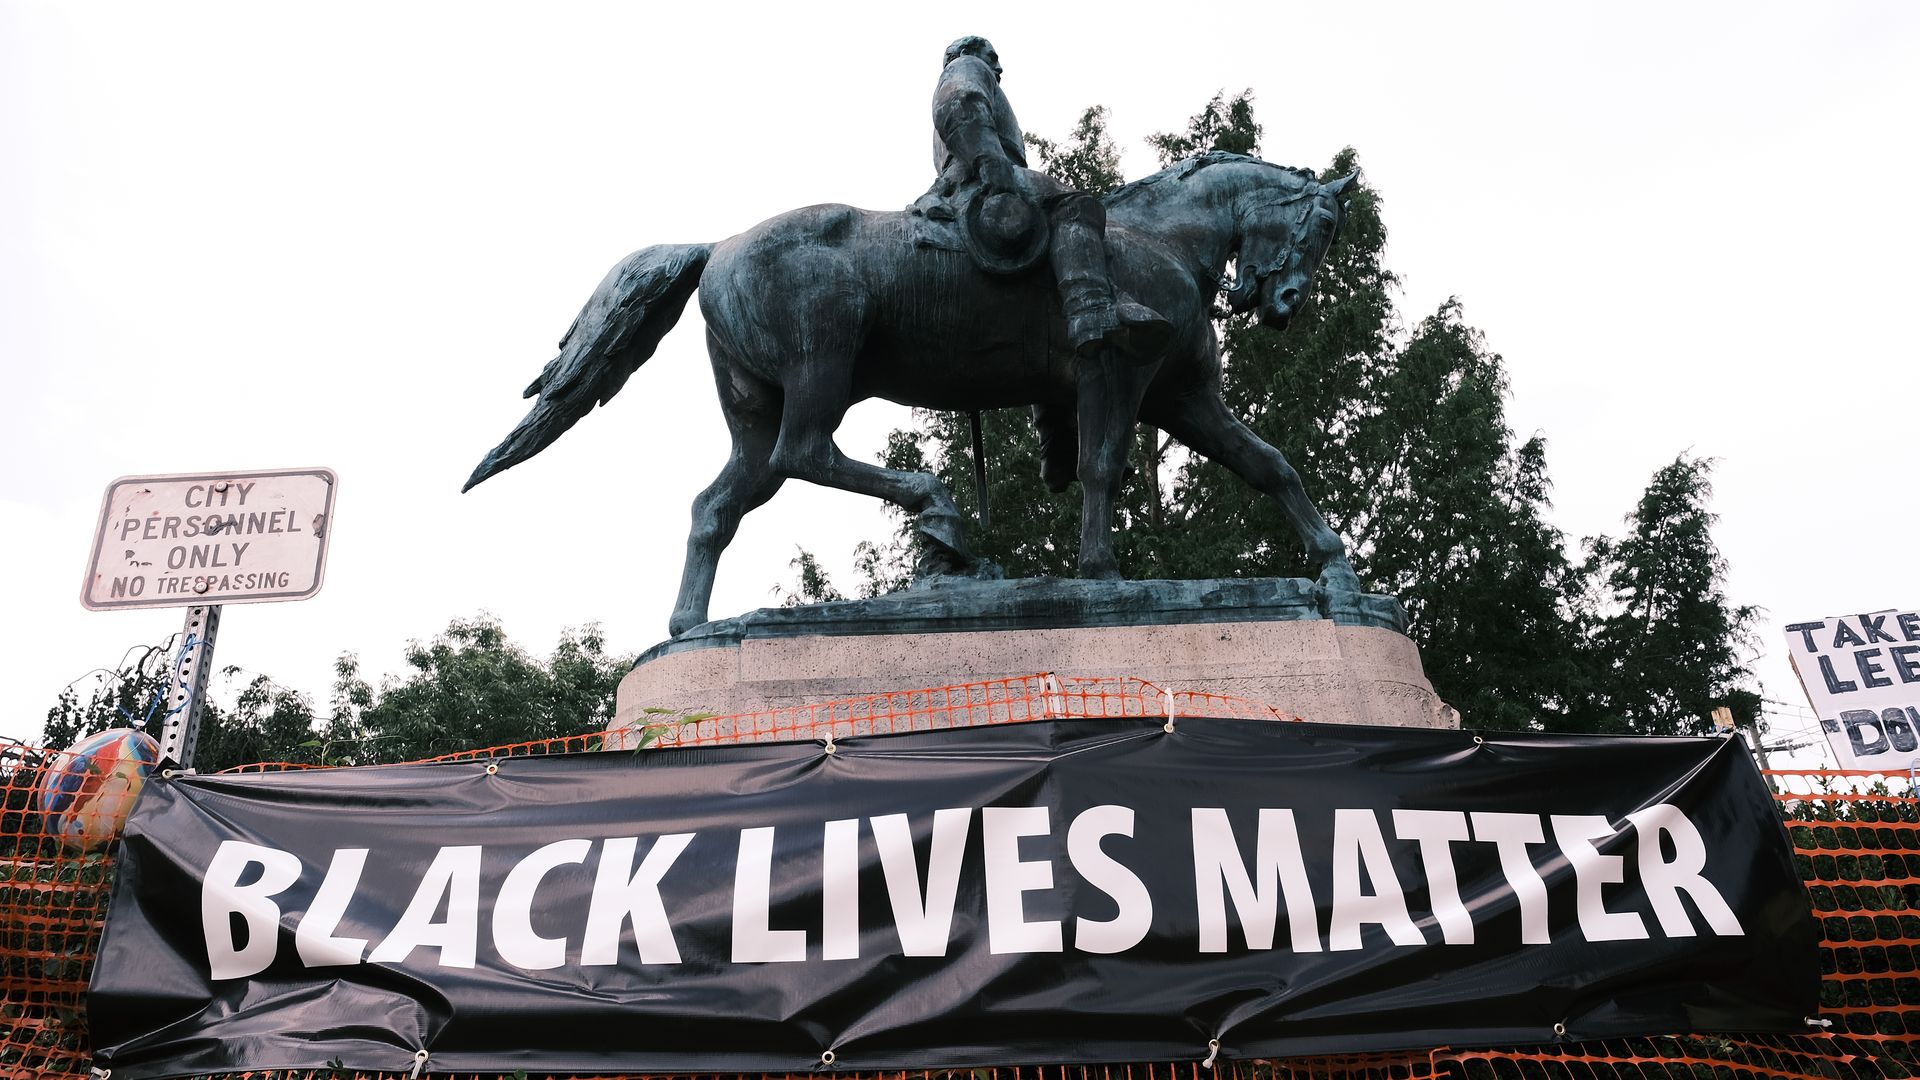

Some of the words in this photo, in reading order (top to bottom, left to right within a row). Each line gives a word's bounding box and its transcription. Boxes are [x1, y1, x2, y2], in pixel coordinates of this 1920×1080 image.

[185, 482, 255, 508] CITY
[120, 510, 301, 541] PERSONNEL
[167, 542, 250, 570] ONLY
[110, 575, 145, 598] NO
[1785, 613, 1920, 653] TAKE
[1817, 645, 1920, 694] LEE
[1840, 706, 1920, 757] DO
[202, 832, 697, 981] BLACK
[732, 805, 1153, 964] LIVES
[1191, 804, 1745, 954] MATTER
